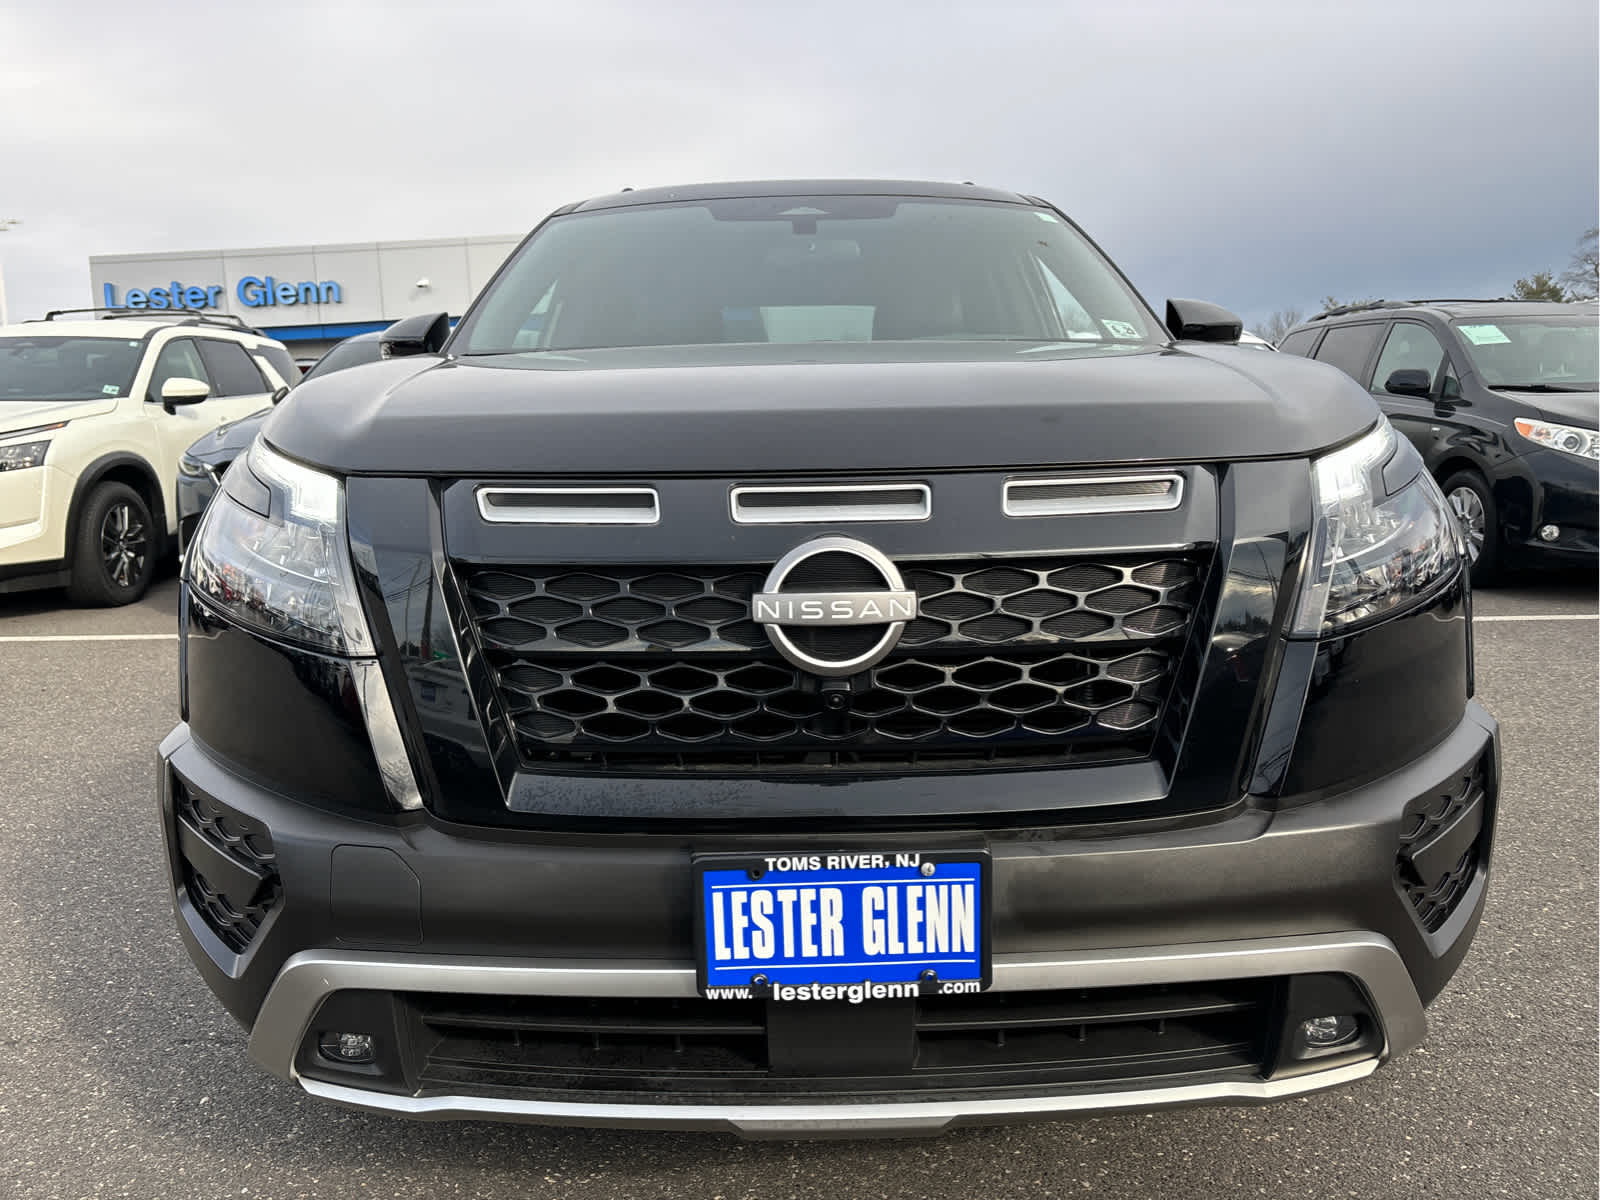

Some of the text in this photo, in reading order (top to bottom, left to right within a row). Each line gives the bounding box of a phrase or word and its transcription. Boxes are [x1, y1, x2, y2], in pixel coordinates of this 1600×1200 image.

[103, 276, 342, 309] Lester Glenn
[757, 599, 911, 619] NISSAN
[765, 853, 920, 872] TOMS RIVER, NJ
[712, 884, 975, 960] LESTER GLENN
[706, 981, 981, 1004] www. lesterglenn .com
